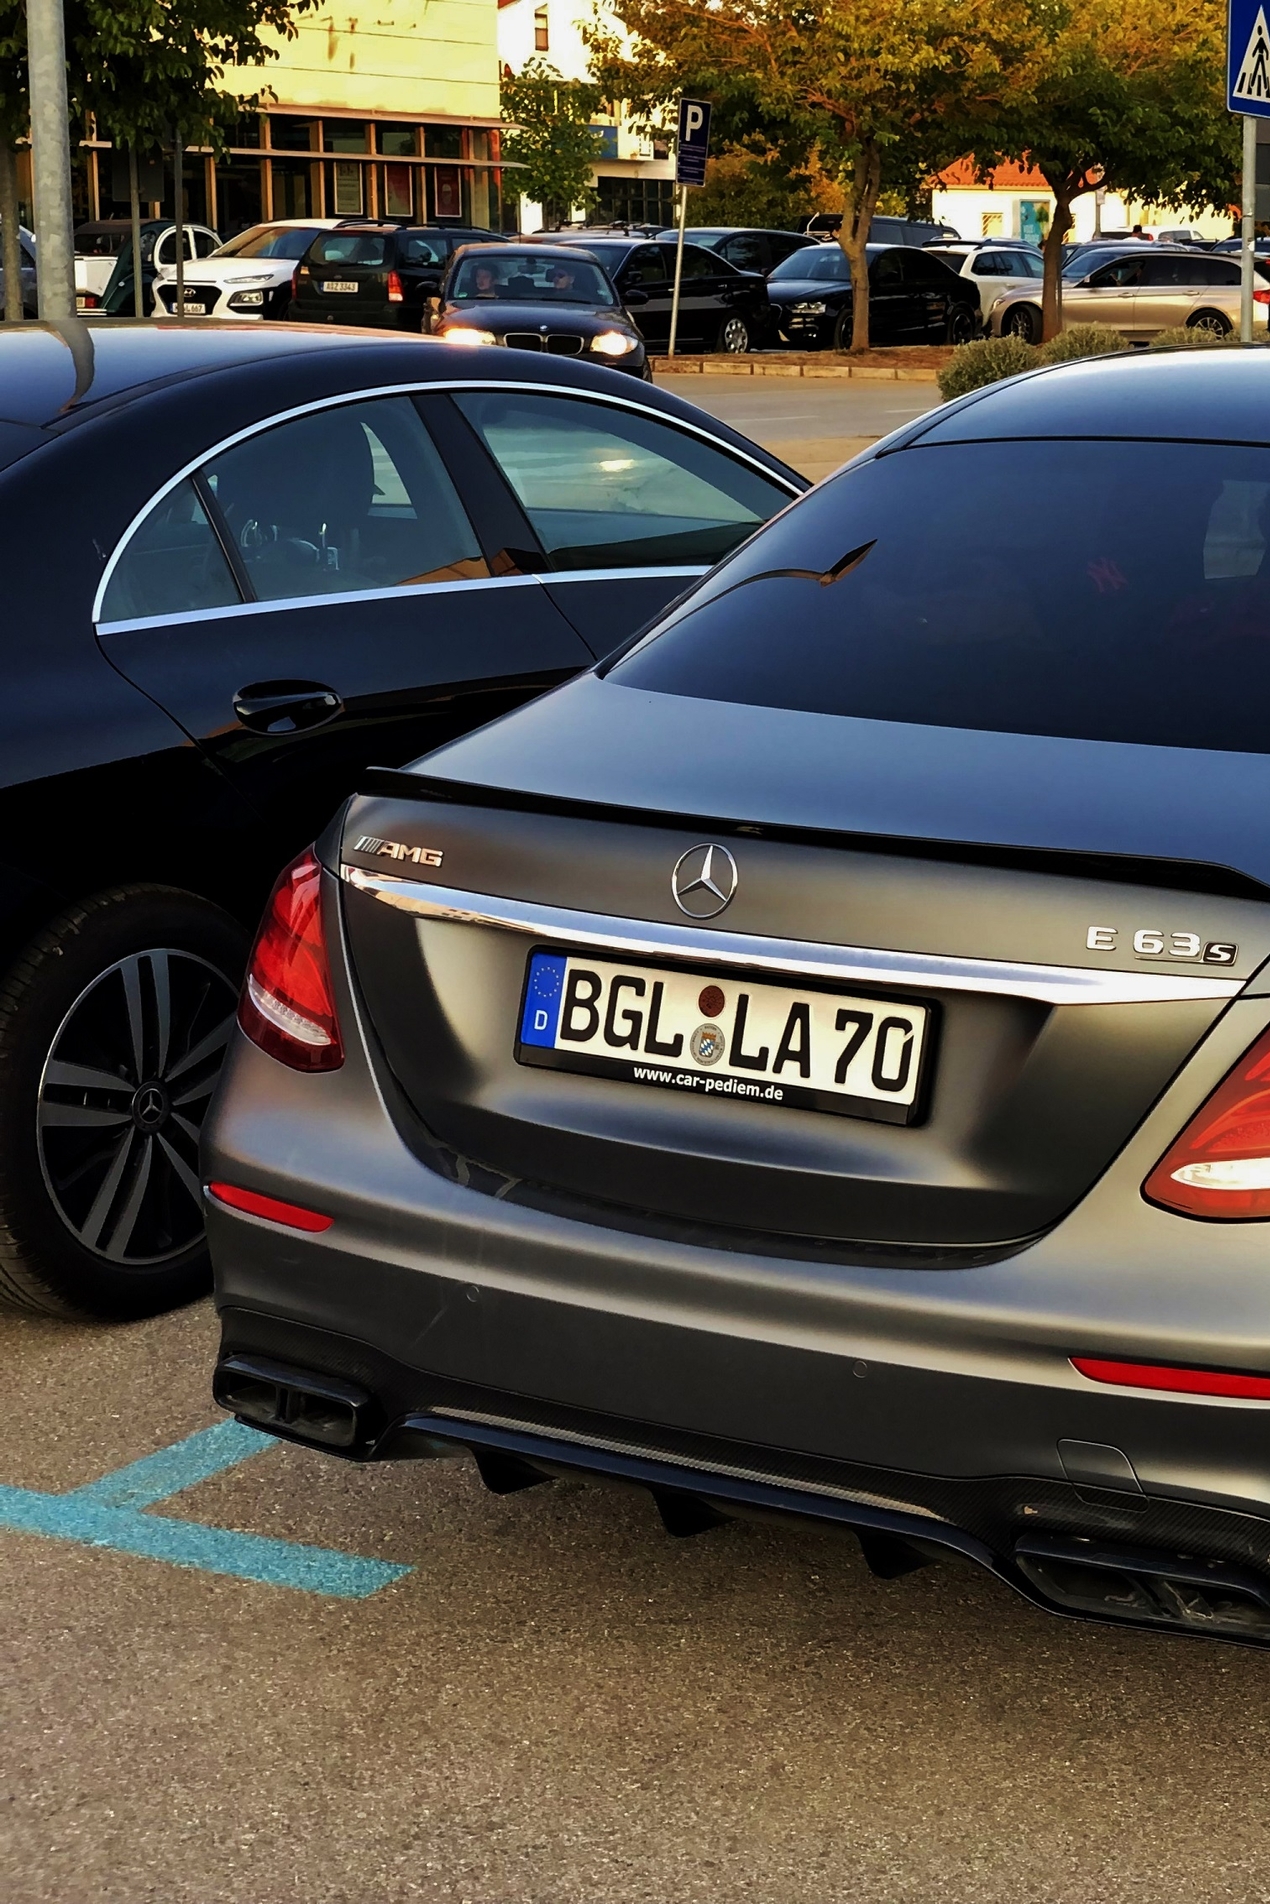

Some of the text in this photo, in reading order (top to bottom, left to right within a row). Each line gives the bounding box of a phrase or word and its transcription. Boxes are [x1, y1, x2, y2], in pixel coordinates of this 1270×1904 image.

[685, 104, 704, 141] P
[376, 841, 443, 867] AMG
[1086, 926, 1118, 951] E
[1133, 929, 1201, 957] 63
[534, 1010, 548, 1031] D
[560, 968, 684, 1058] BGL
[728, 993, 811, 1079] LA
[834, 1008, 914, 1093] 70
[633, 1067, 784, 1101] www.car-pediem.de
